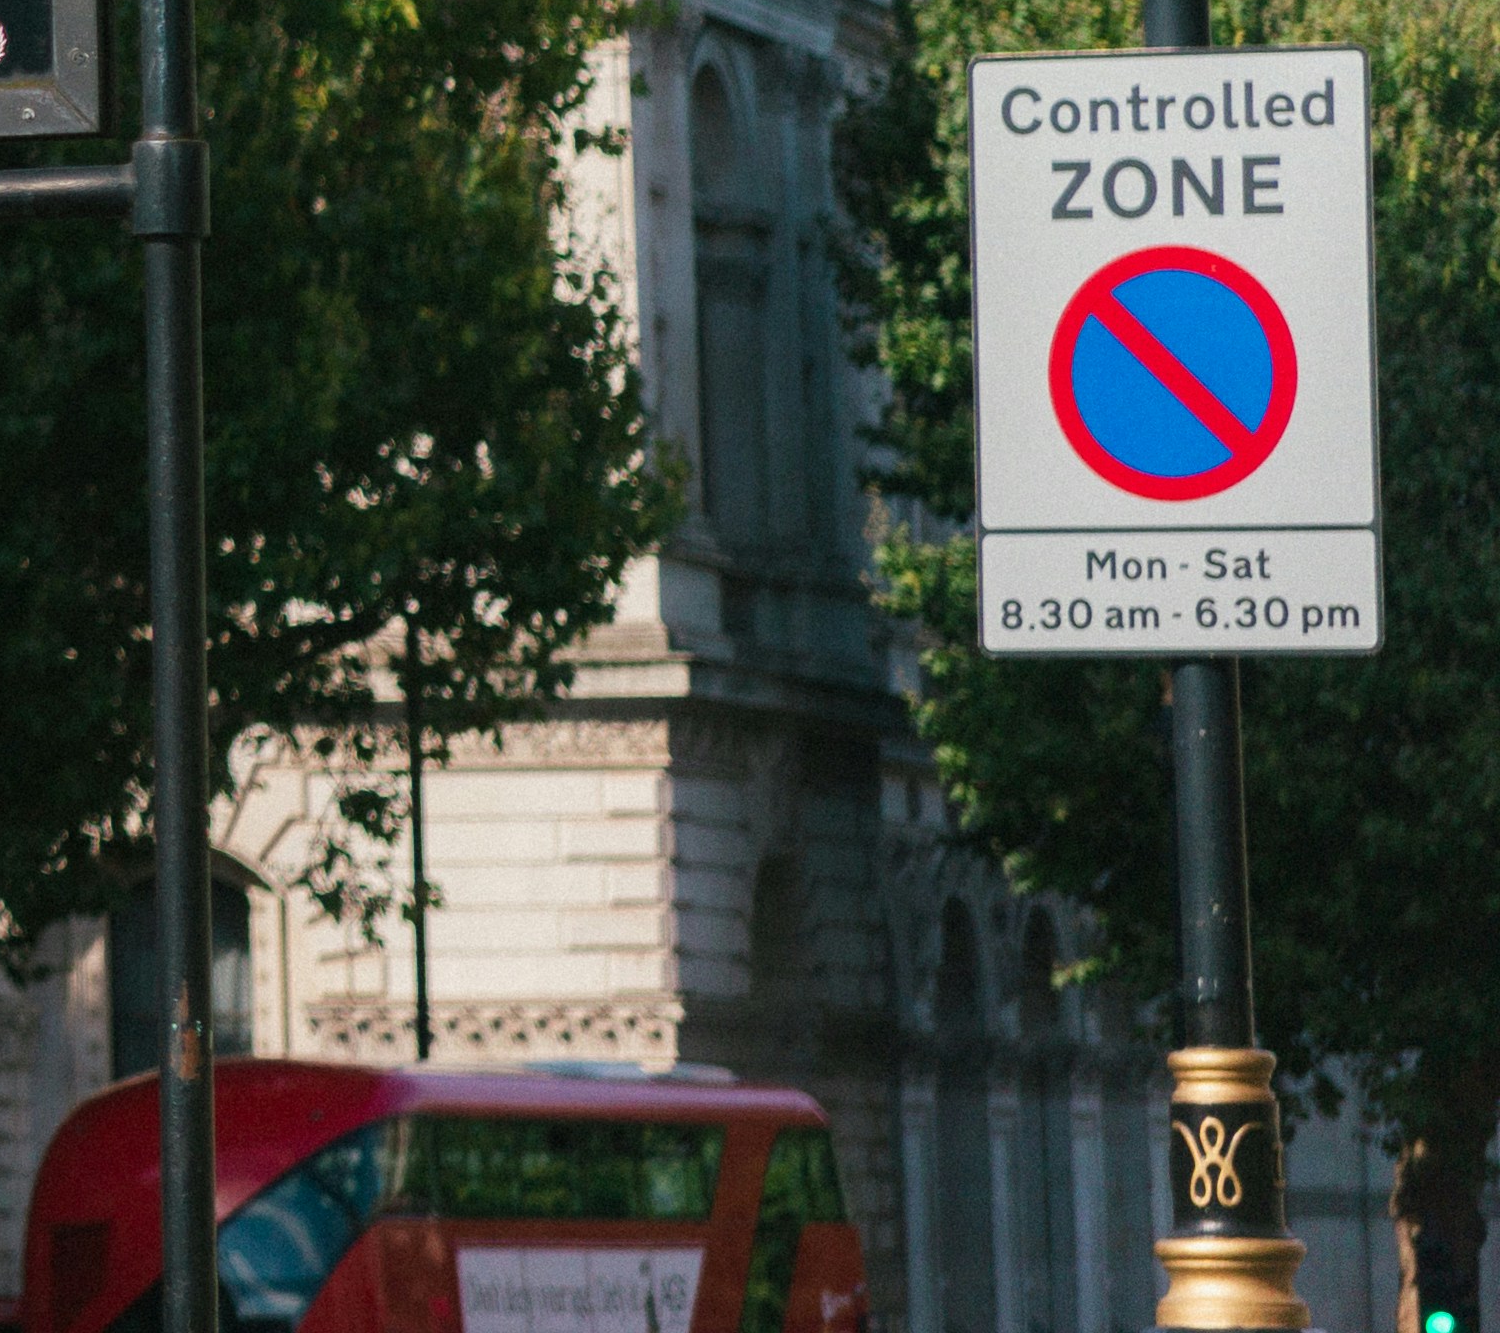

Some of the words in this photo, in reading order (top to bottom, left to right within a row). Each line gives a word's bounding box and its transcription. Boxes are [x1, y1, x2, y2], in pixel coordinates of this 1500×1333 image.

[1001, 78, 1336, 136] Controlled
[1051, 156, 1285, 221] ZONE
[1086, 549, 1168, 581] Mon
[1203, 547, 1272, 580] Sat
[1001, 598, 1094, 631] 8.30
[1105, 606, 1161, 630] am
[1195, 595, 1290, 630] 6.30
[1301, 604, 1361, 635] pm
